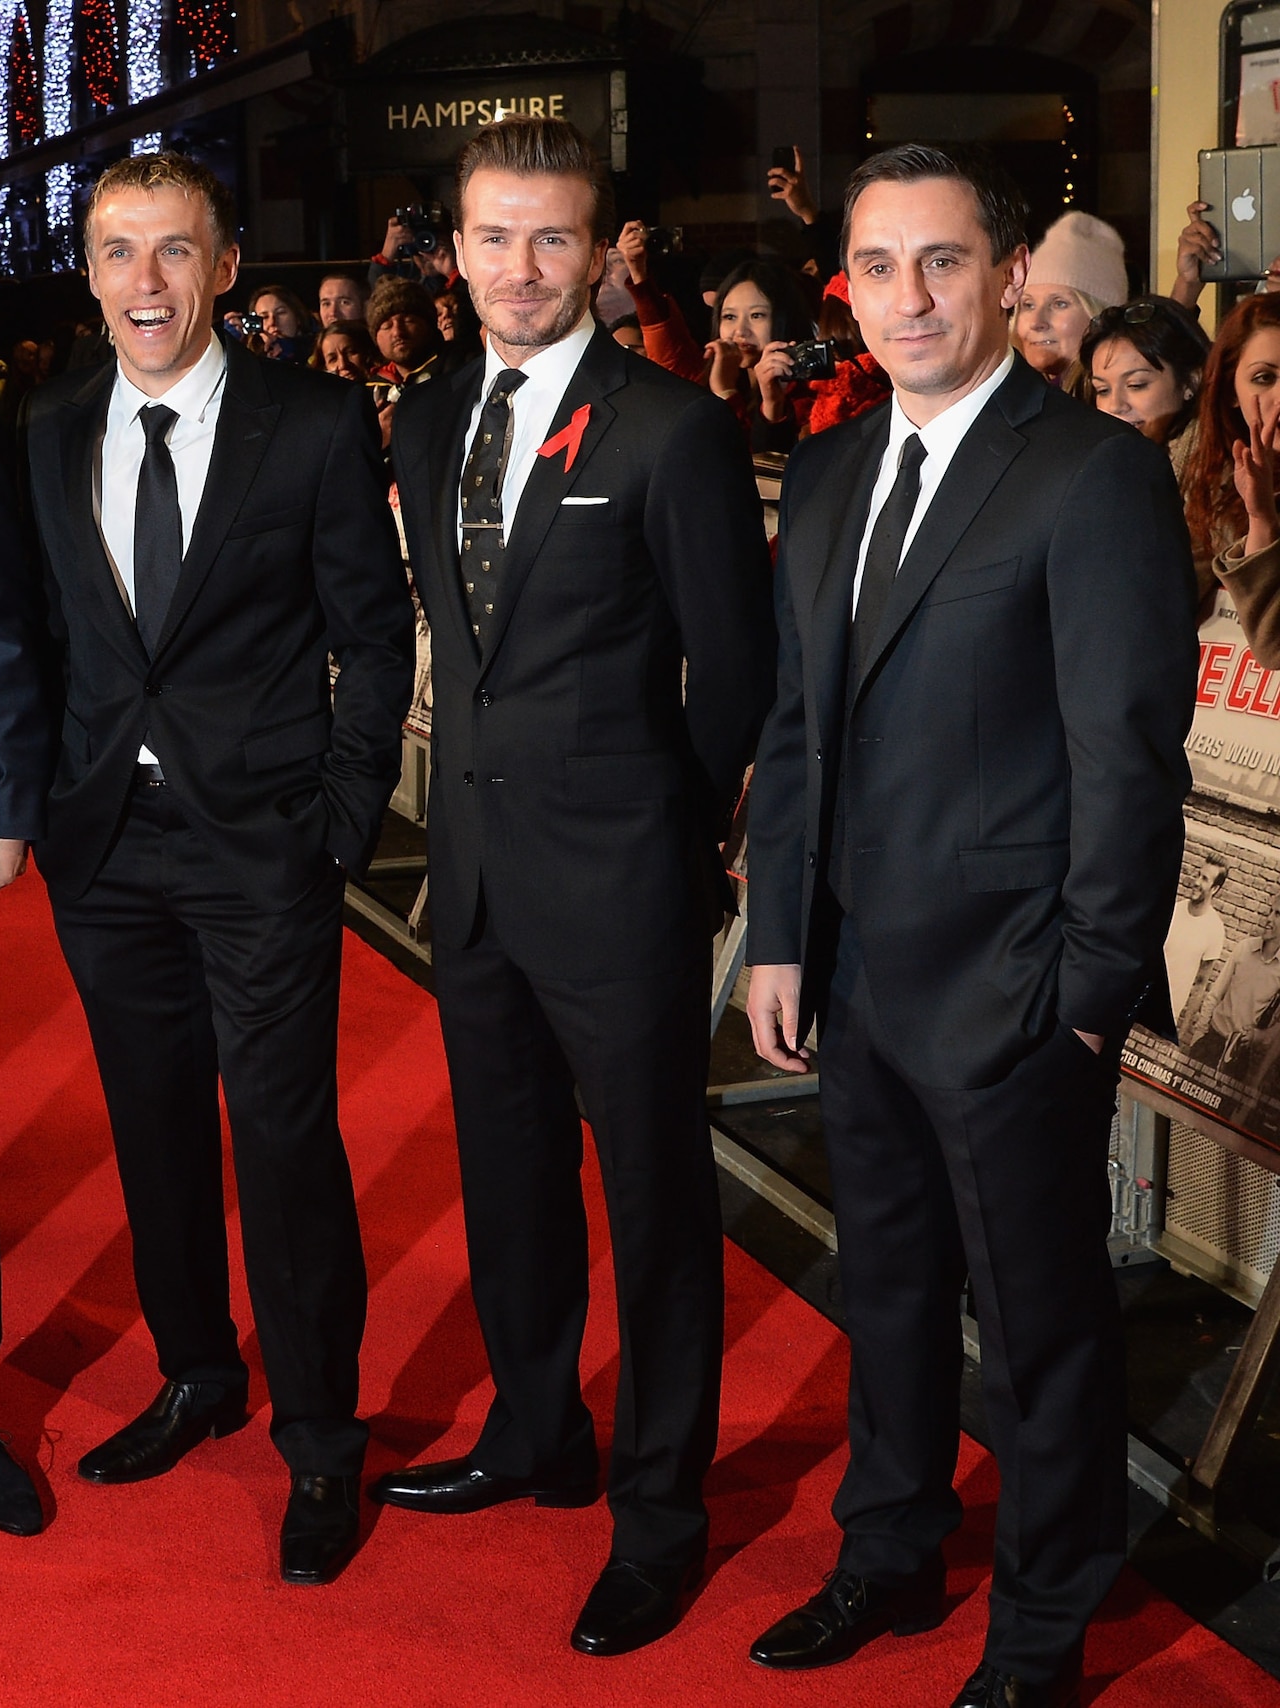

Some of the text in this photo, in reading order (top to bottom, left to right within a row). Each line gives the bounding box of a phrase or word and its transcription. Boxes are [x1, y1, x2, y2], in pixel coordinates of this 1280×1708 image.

[387, 95, 565, 130] HAMPSHIRE
[1186, 731, 1225, 759] YERS
[1225, 741, 1263, 770] WHO
[1136, 1056, 1173, 1085] CINEMAS
[1180, 1080, 1224, 1110] DECEMBER
